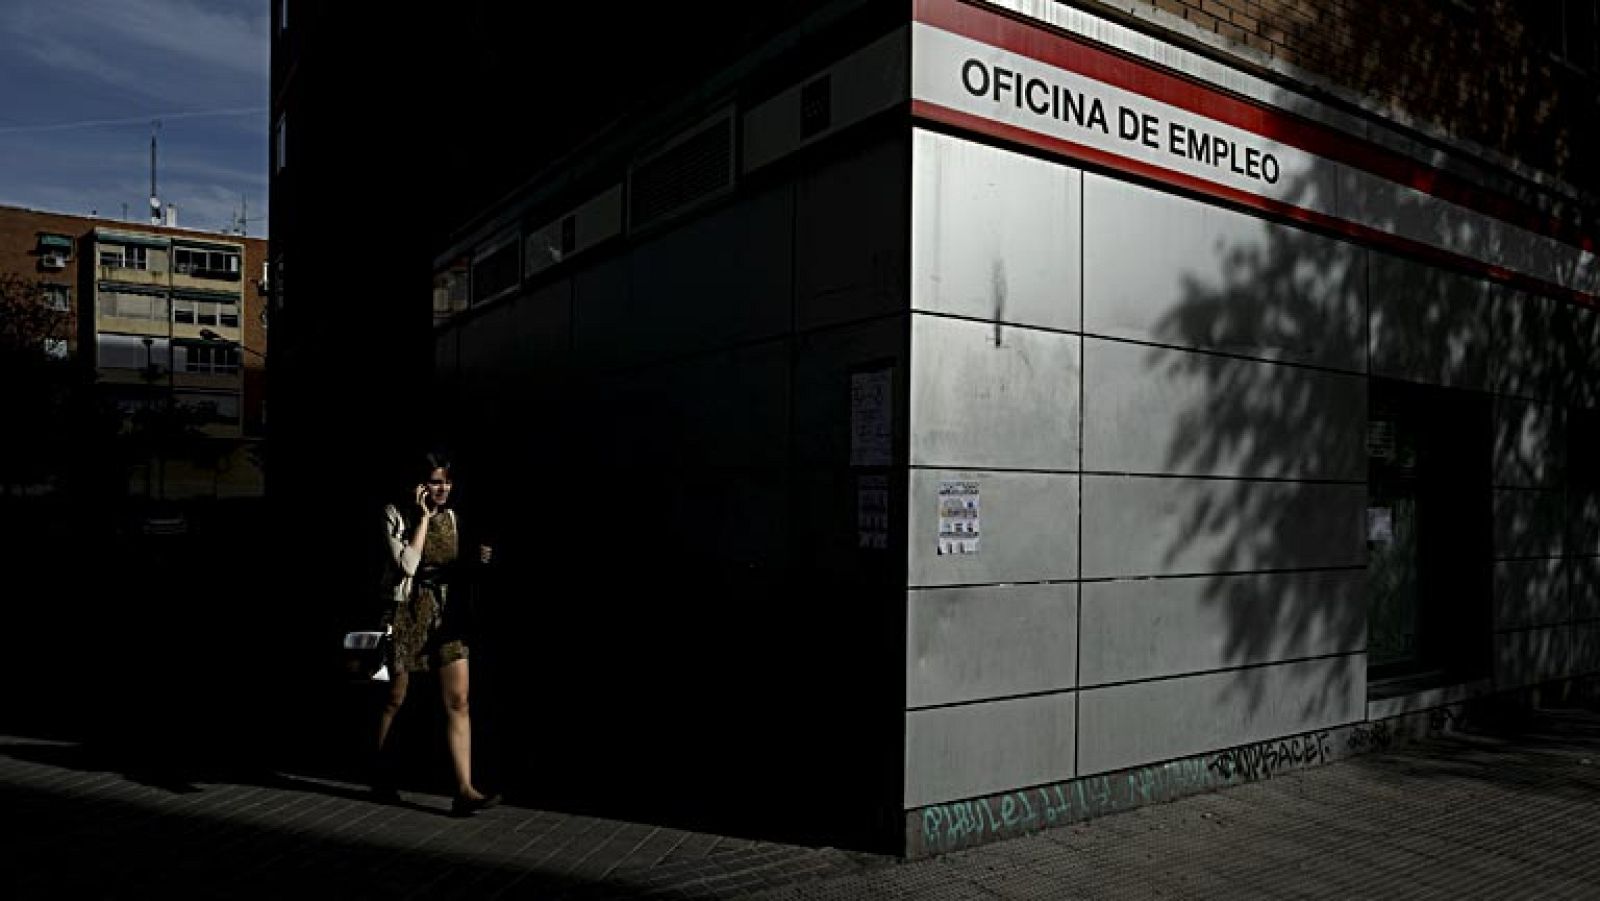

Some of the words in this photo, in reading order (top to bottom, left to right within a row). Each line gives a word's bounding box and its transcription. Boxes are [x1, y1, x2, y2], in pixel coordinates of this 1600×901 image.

[962, 58, 1109, 134] OFICINA
[1119, 106, 1159, 149] DE
[1169, 122, 1280, 184] EMPLEO
